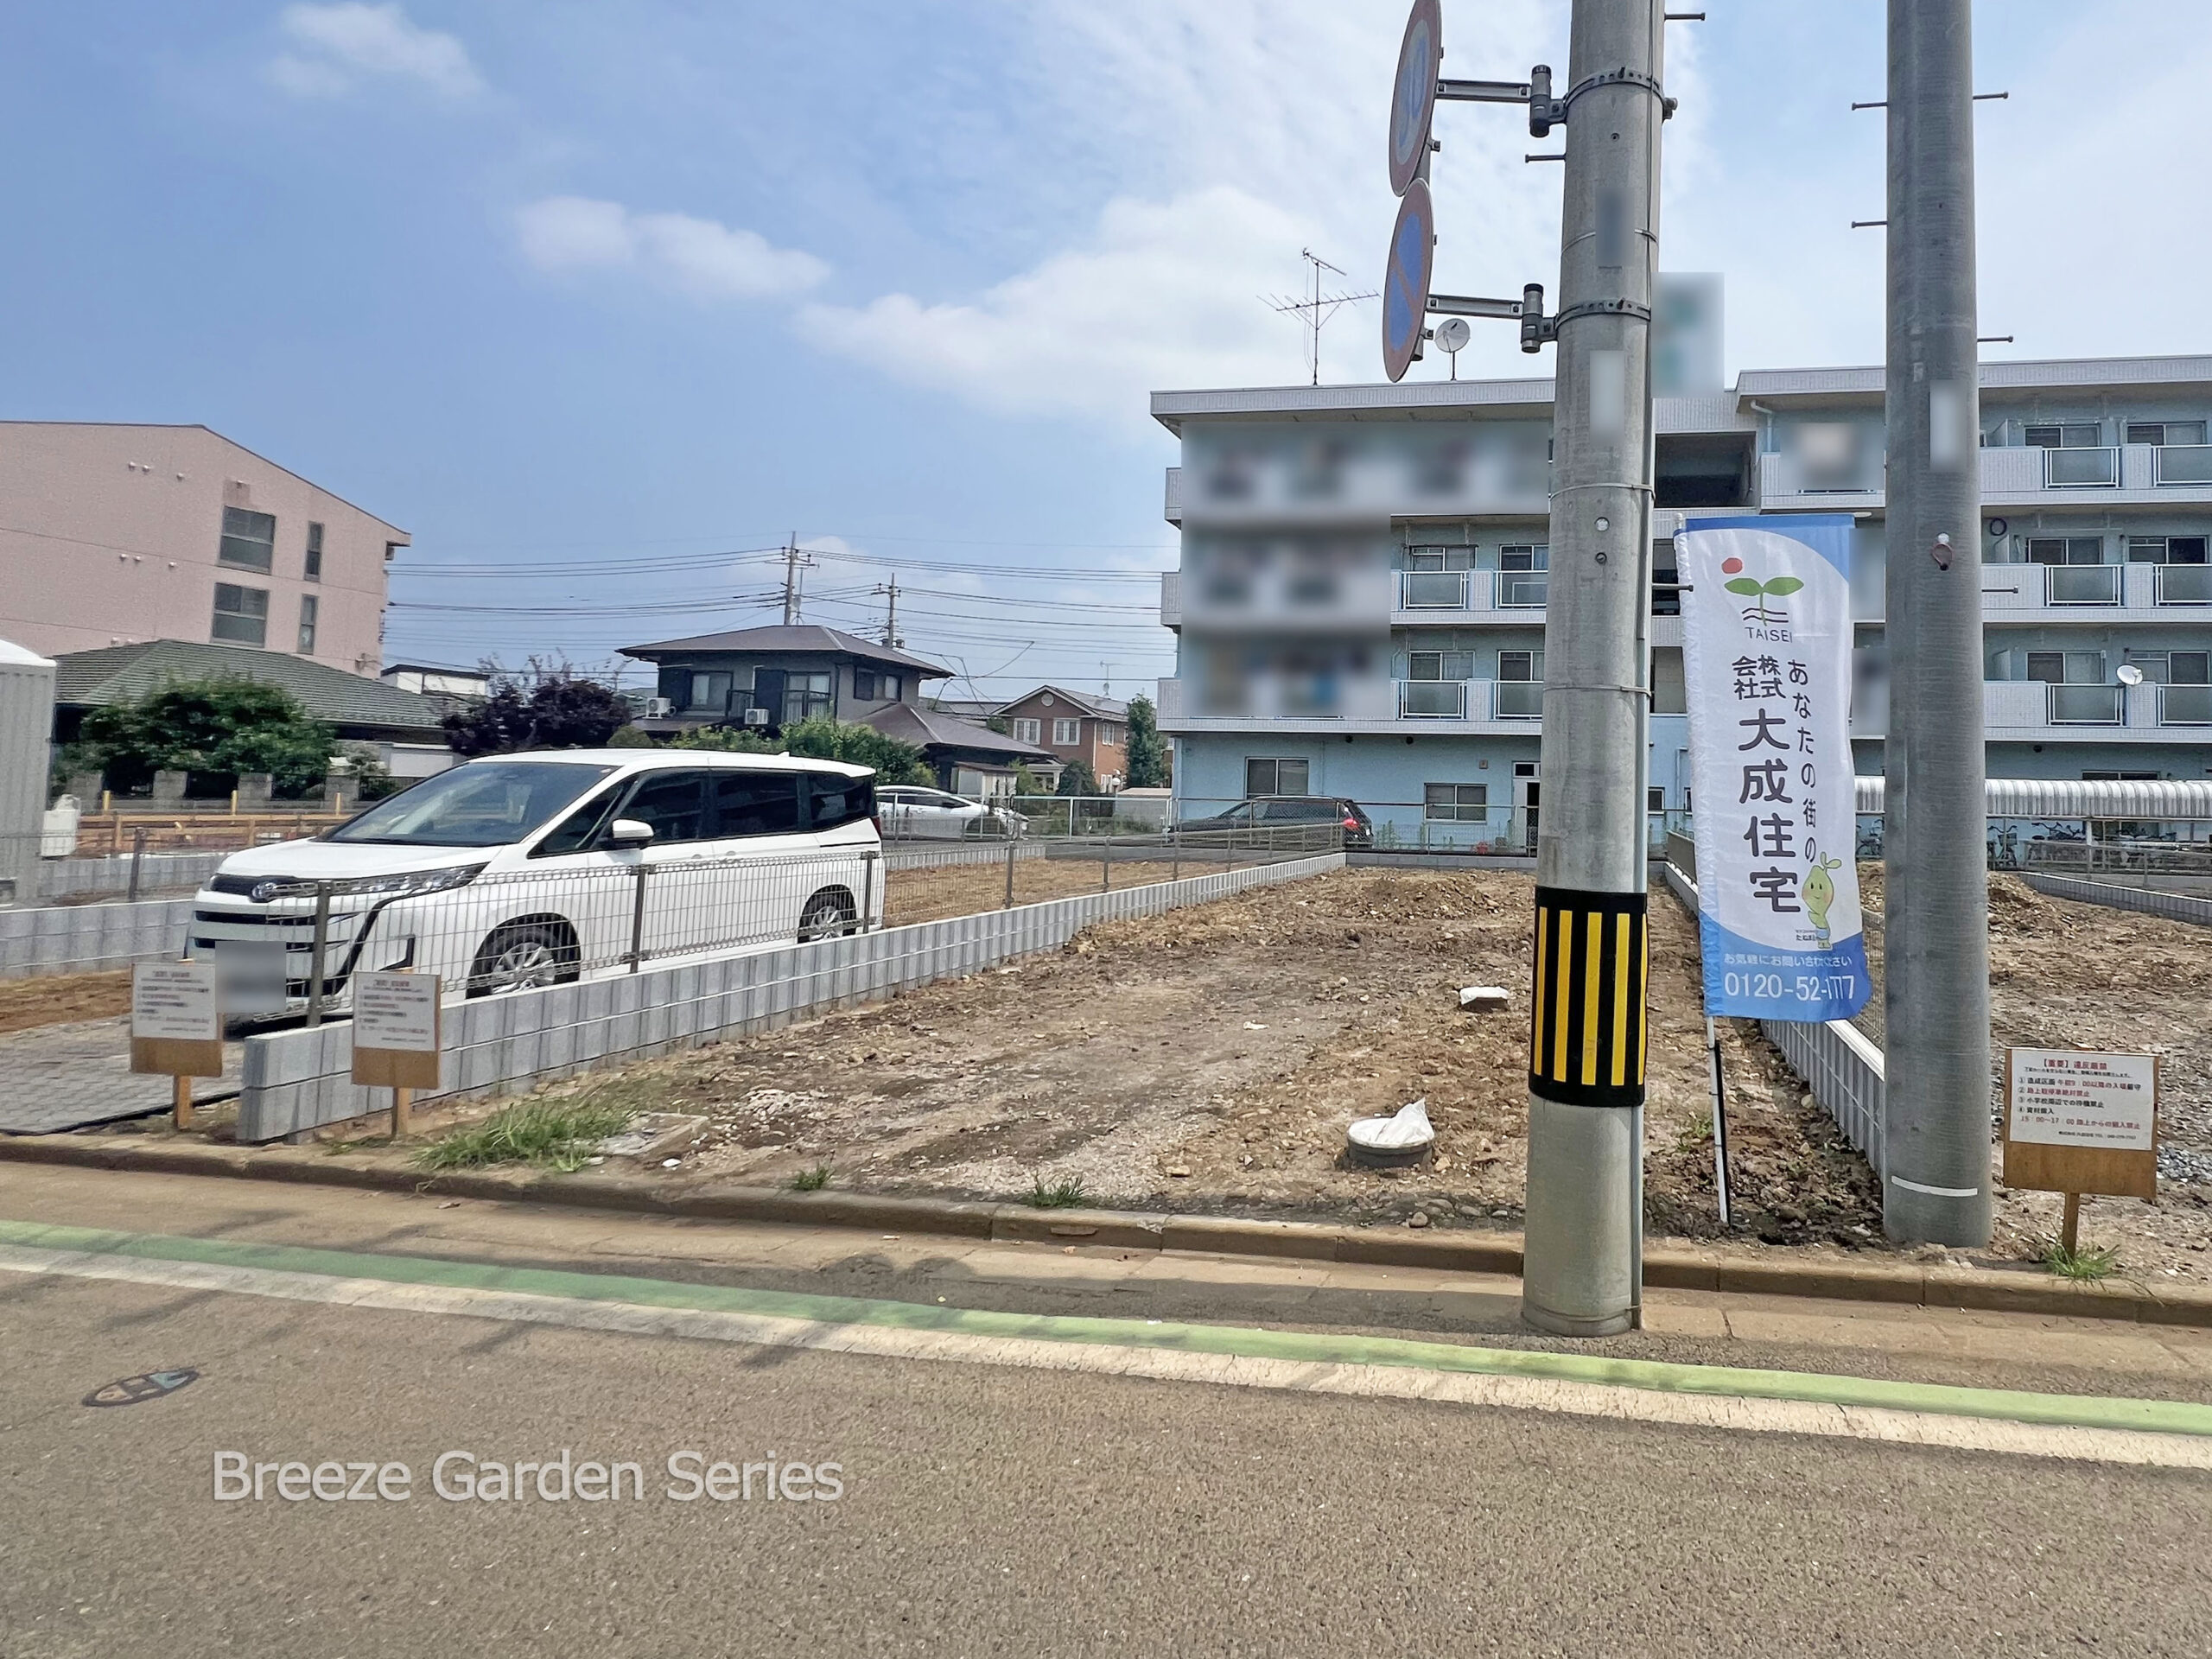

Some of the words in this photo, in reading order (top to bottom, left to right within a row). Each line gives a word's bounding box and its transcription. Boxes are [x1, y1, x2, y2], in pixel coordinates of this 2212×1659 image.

[1745, 626, 1793, 643] TAISEI
[1787, 659, 1816, 863] あなたの街の
